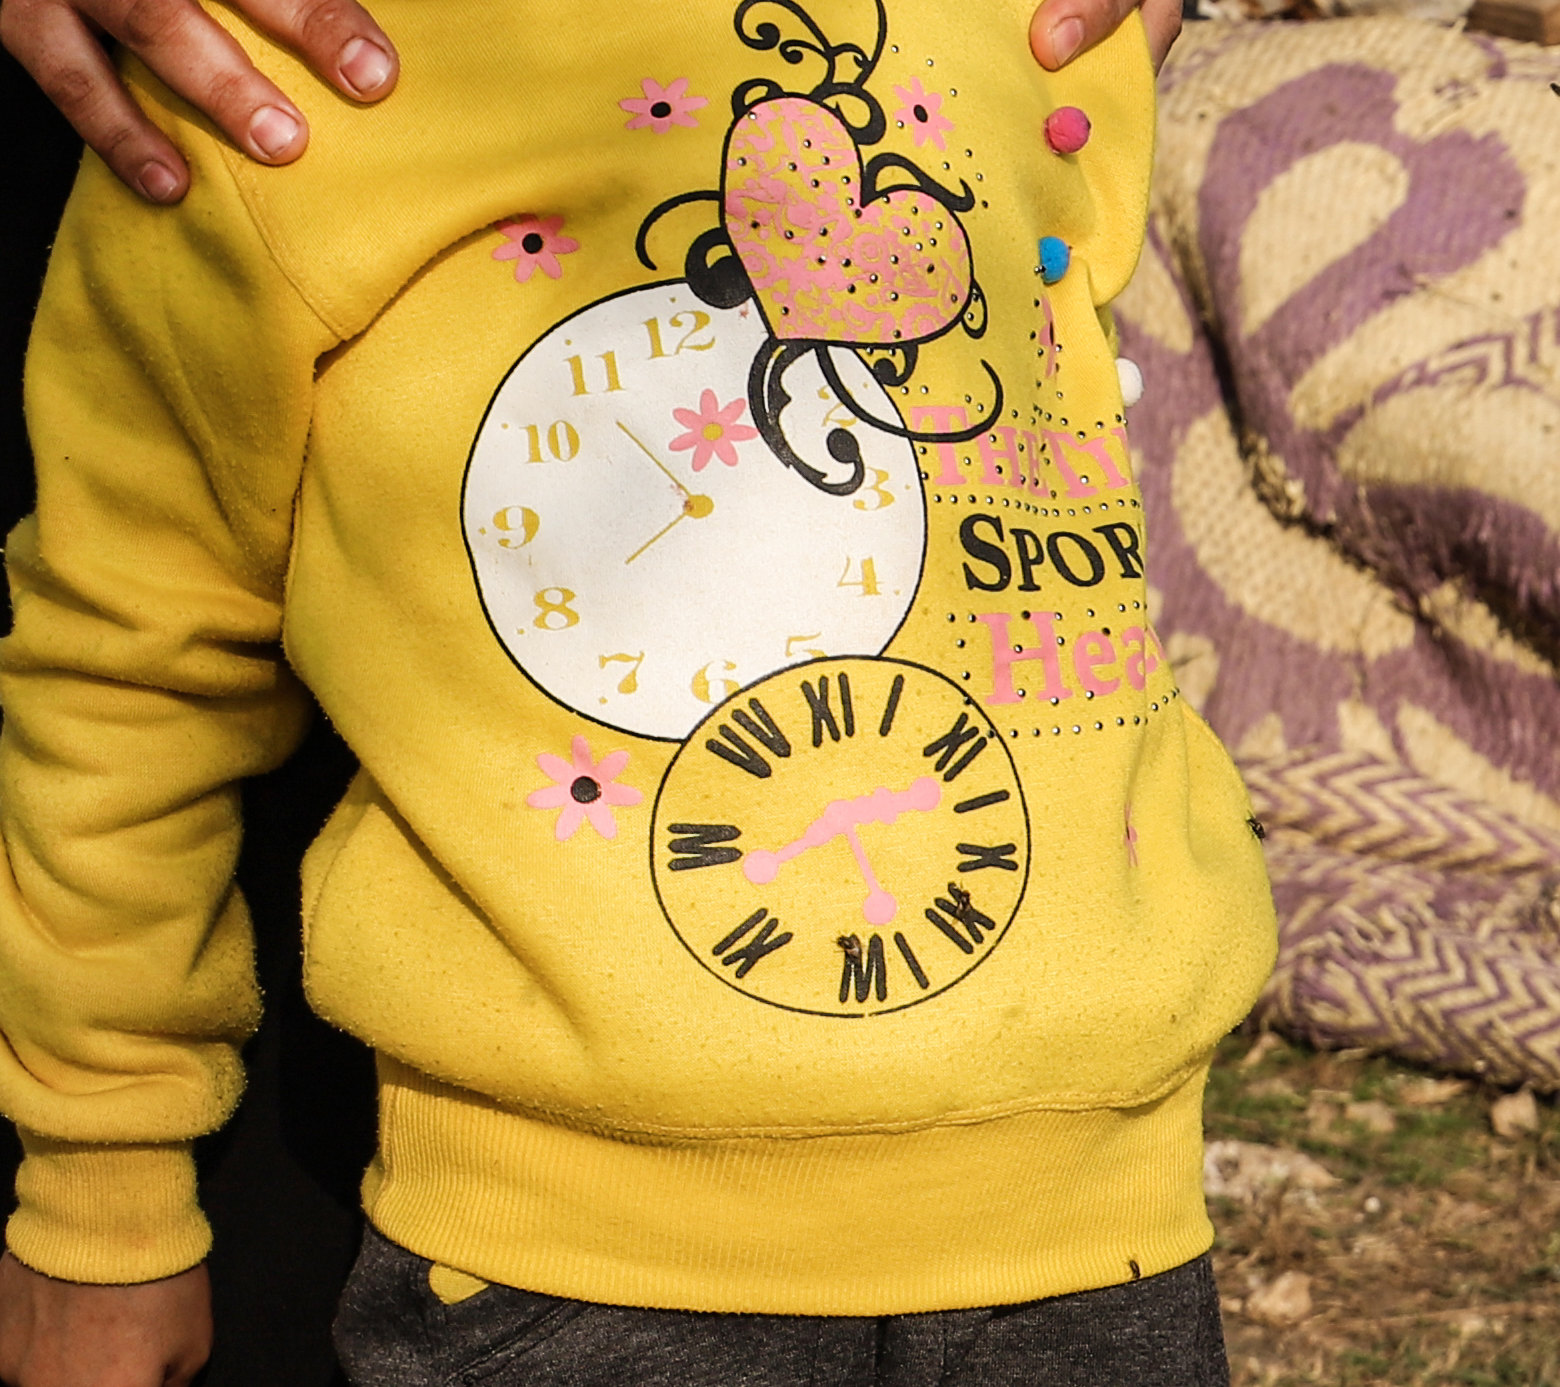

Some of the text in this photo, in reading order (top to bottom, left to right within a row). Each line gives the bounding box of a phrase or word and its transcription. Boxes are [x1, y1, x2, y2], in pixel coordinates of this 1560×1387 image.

[640, 310, 716, 360] 12
[563, 350, 626, 397] 11
[519, 419, 580, 464] 10
[852, 467, 896, 511] 3
[493, 506, 540, 549] 9
[836, 557, 883, 596] 4
[532, 587, 580, 630] 8
[598, 650, 645, 694] 7
[975, 611, 1166, 705] Hea
[690, 661, 741, 704] 6
